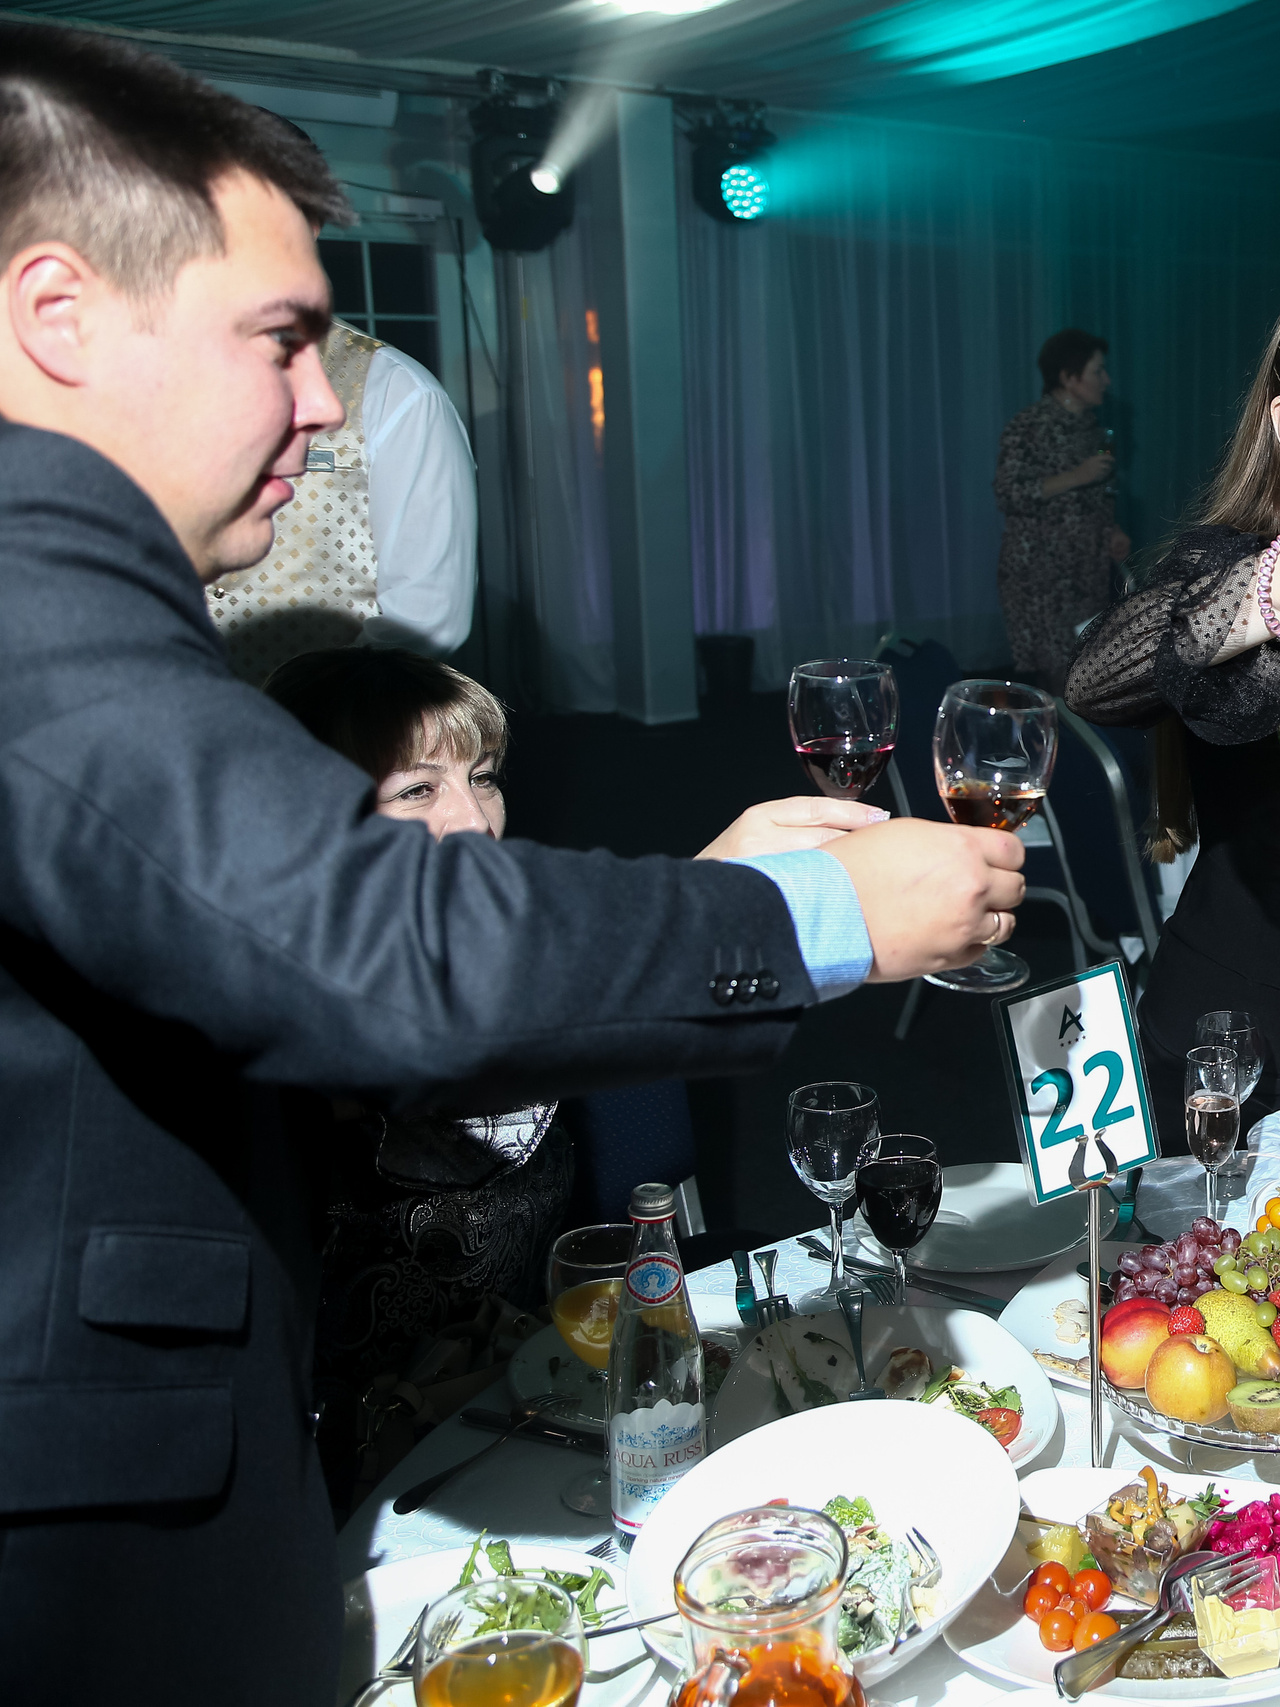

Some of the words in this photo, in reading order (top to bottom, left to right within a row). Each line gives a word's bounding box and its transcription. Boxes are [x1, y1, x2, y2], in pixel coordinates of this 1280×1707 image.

[1030, 1050, 1135, 1149] 22
[614, 1448, 657, 1468] AQUA
[664, 1440, 705, 1467] RUSS
